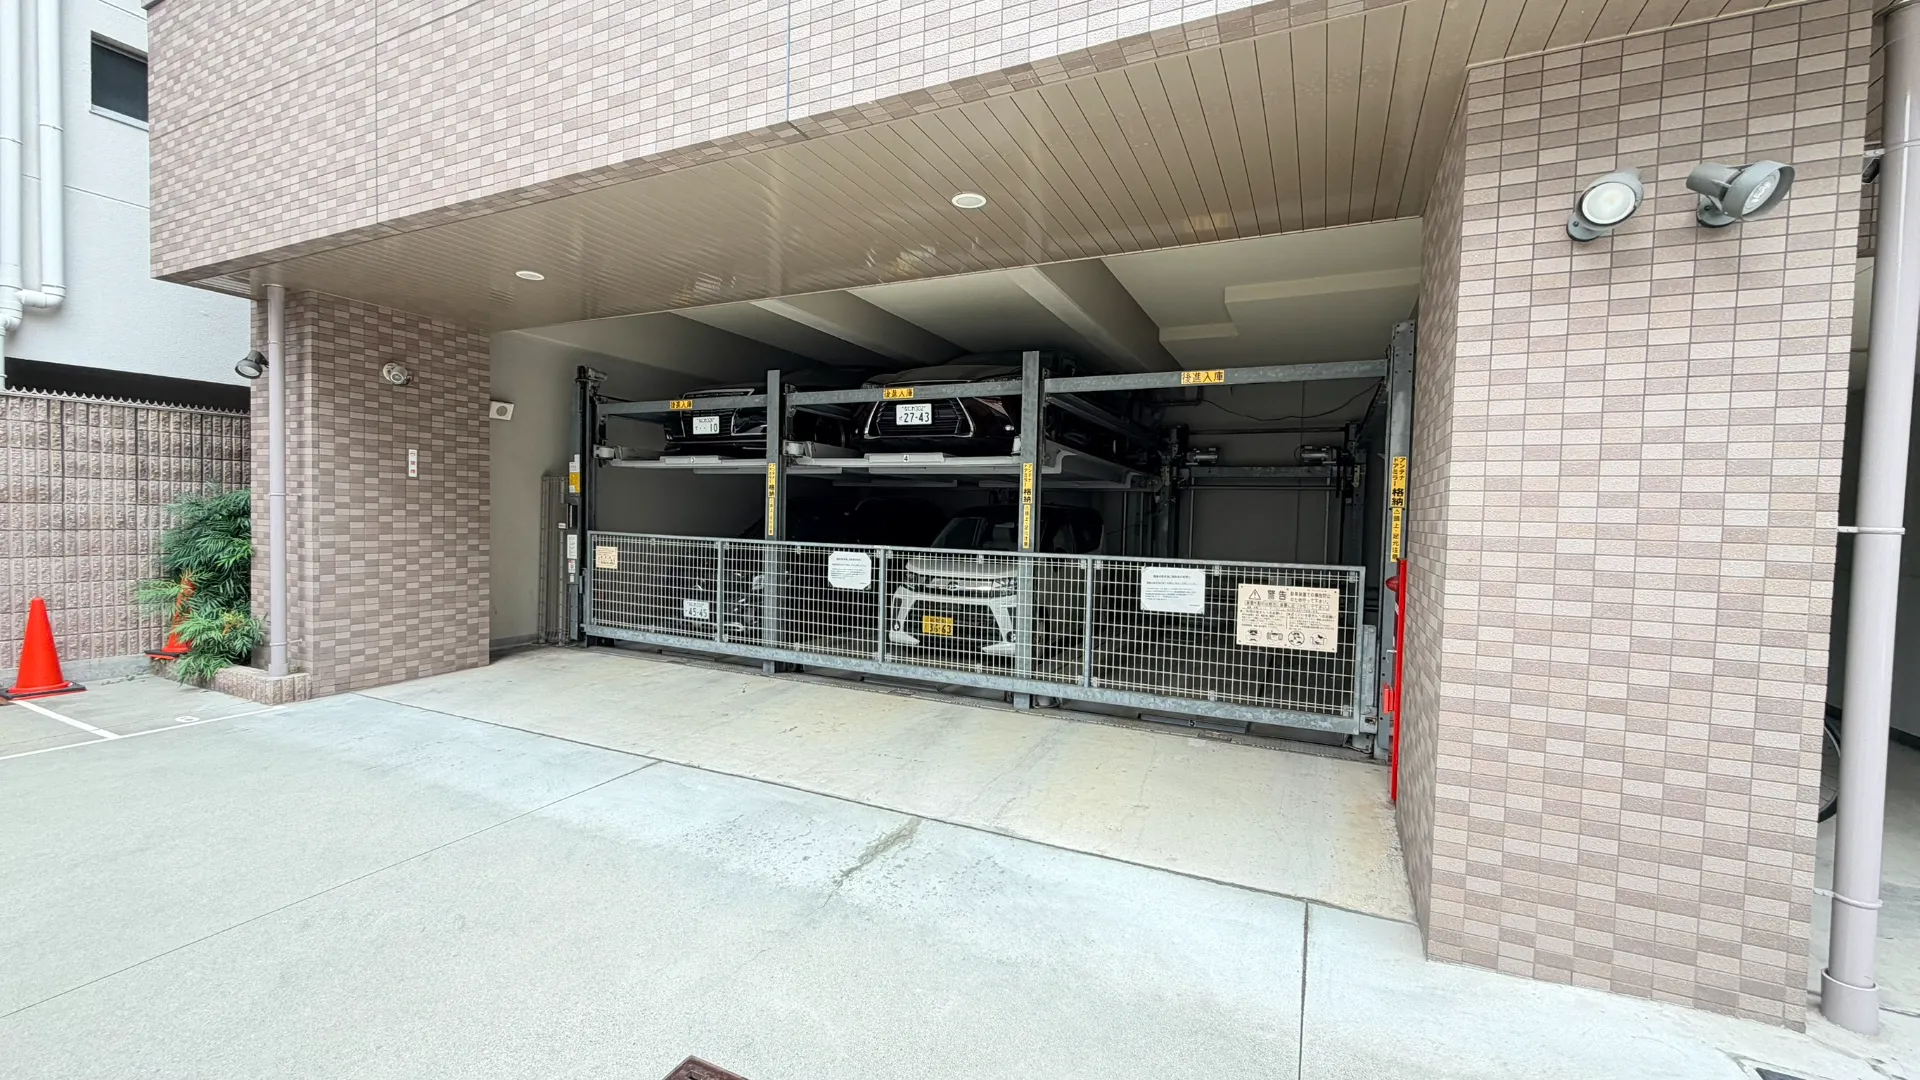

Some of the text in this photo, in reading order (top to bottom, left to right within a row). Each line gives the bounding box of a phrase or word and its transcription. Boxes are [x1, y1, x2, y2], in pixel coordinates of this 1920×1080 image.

[1182, 371, 1224, 384] 後進入庫
[904, 411, 930, 423] 27-43
[1391, 488, 1404, 506] 格納
